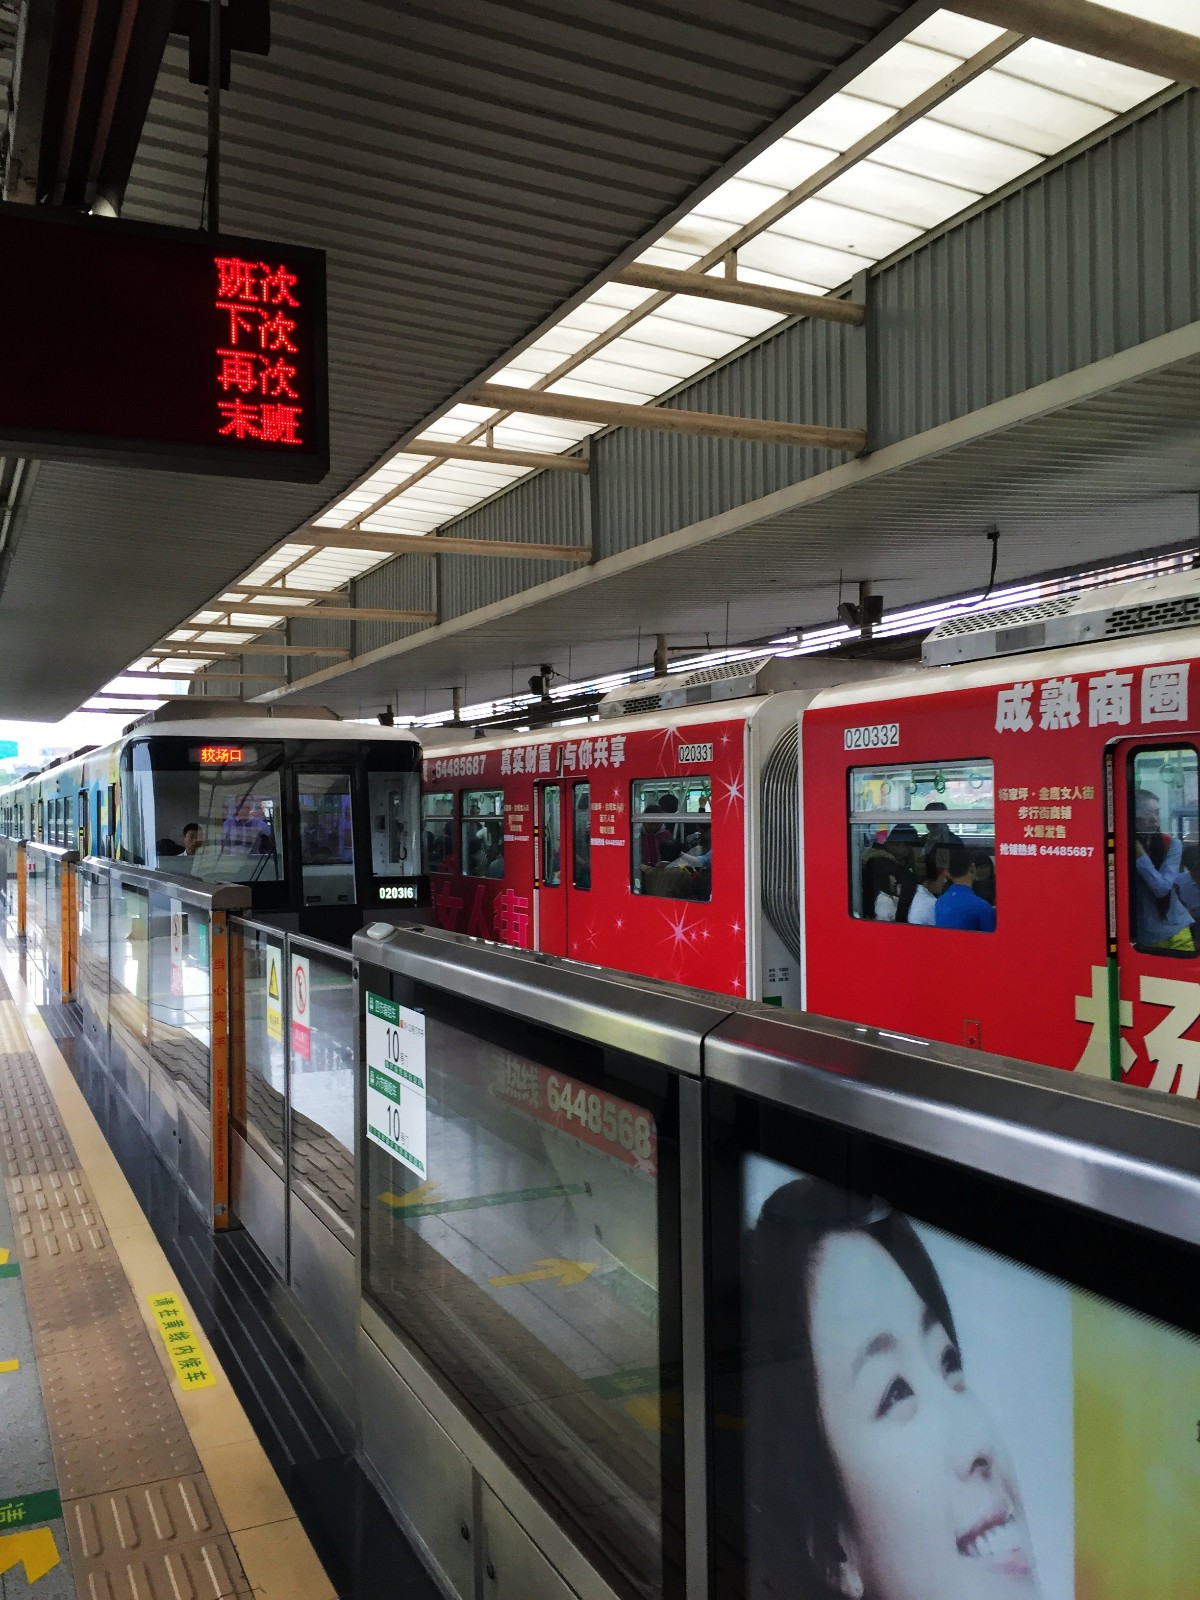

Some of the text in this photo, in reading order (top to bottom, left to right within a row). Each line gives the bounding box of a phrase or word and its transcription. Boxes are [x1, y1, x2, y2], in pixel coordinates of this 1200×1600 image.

[214, 257, 300, 307] 班次
[215, 302, 299, 353] 下次
[216, 349, 299, 398] 再次
[217, 398, 303, 444] 末班
[994, 663, 1191, 734] 成熟商圈
[201, 747, 242, 763] 较场口
[435, 754, 487, 779] 64485687
[500, 744, 551, 775] 真实财富
[563, 735, 627, 771] 与你共享
[679, 744, 713, 762] 020331
[845, 724, 898, 748] 020332
[1039, 845, 1094, 857] 64485687
[379, 886, 414, 899] 020316
[153, 1297, 207, 1383] 请在黄线内候车
